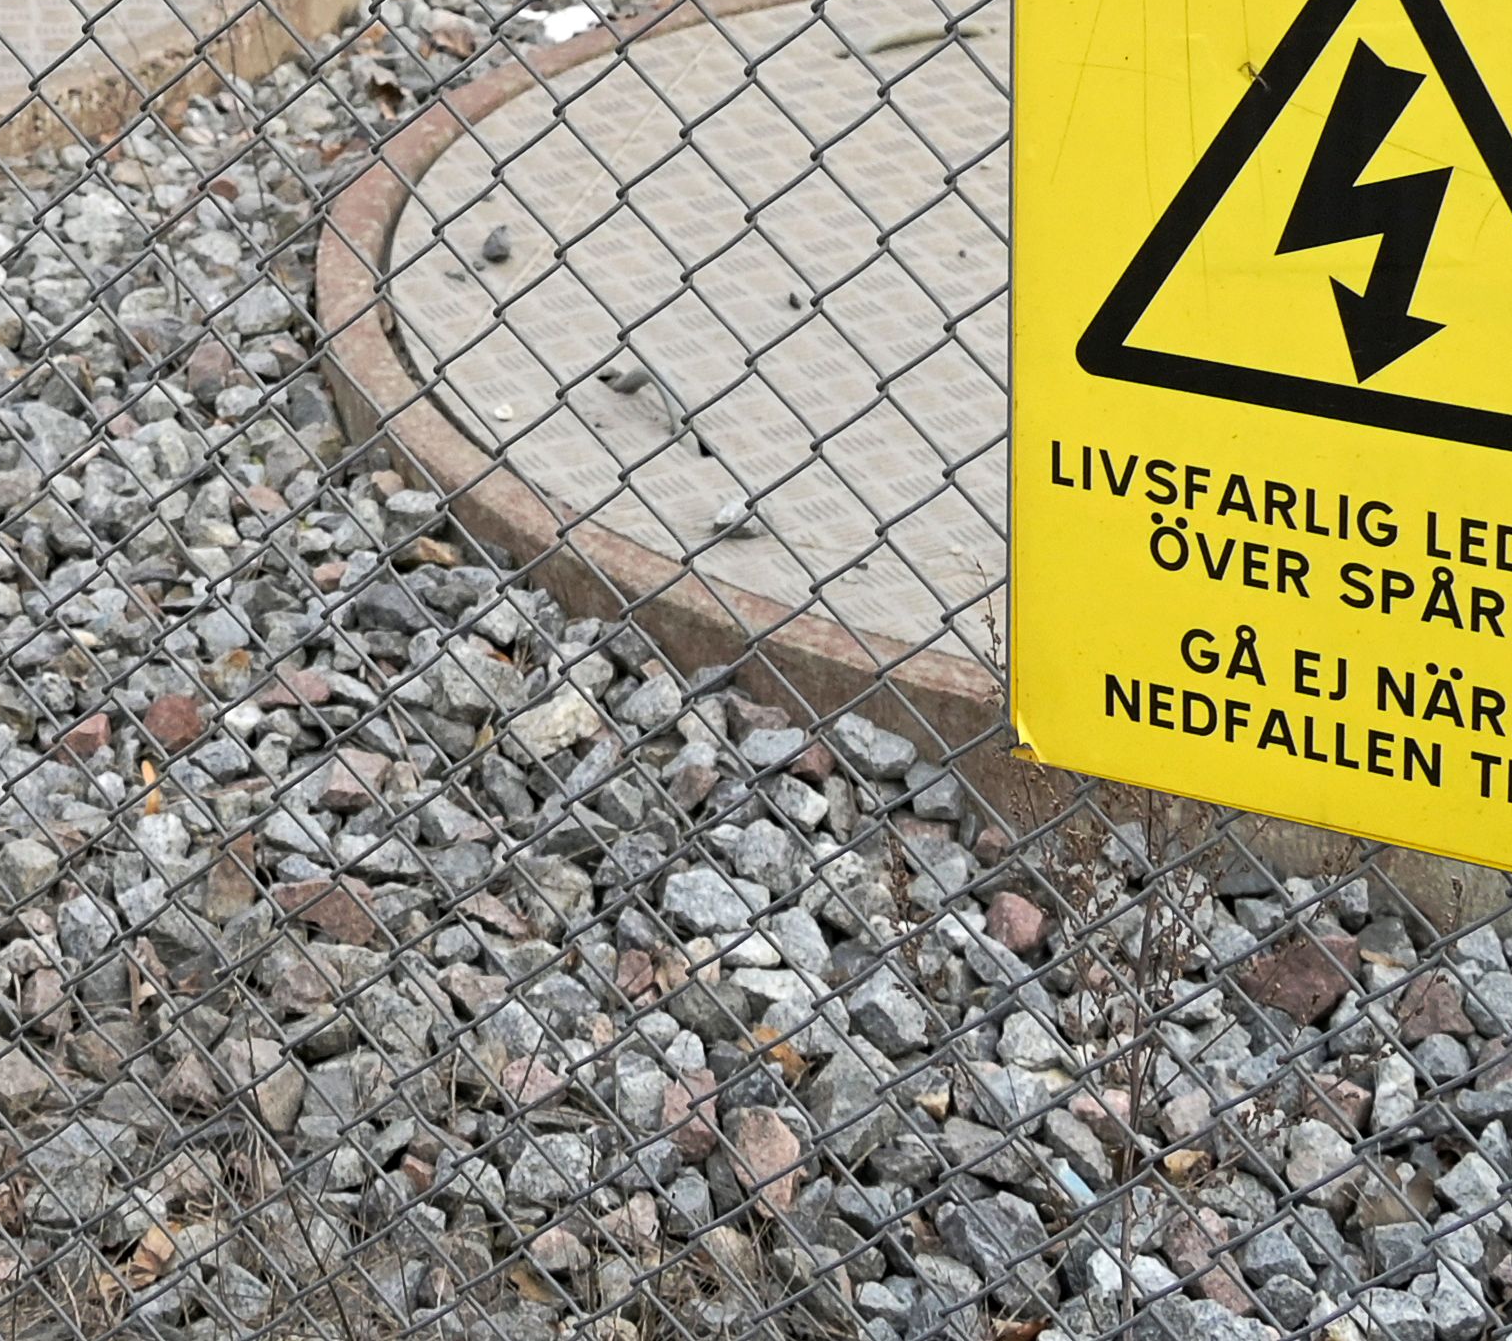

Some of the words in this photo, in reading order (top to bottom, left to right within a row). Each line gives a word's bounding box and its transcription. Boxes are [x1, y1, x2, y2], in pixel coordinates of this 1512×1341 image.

[1051, 439, 1398, 548] LIVSFARLIG
[1149, 511, 1311, 599] ÖVER
[1180, 624, 1267, 687] GÅ
[1294, 648, 1348, 702] EJ
[1104, 673, 1442, 788] NEDFALLEN
